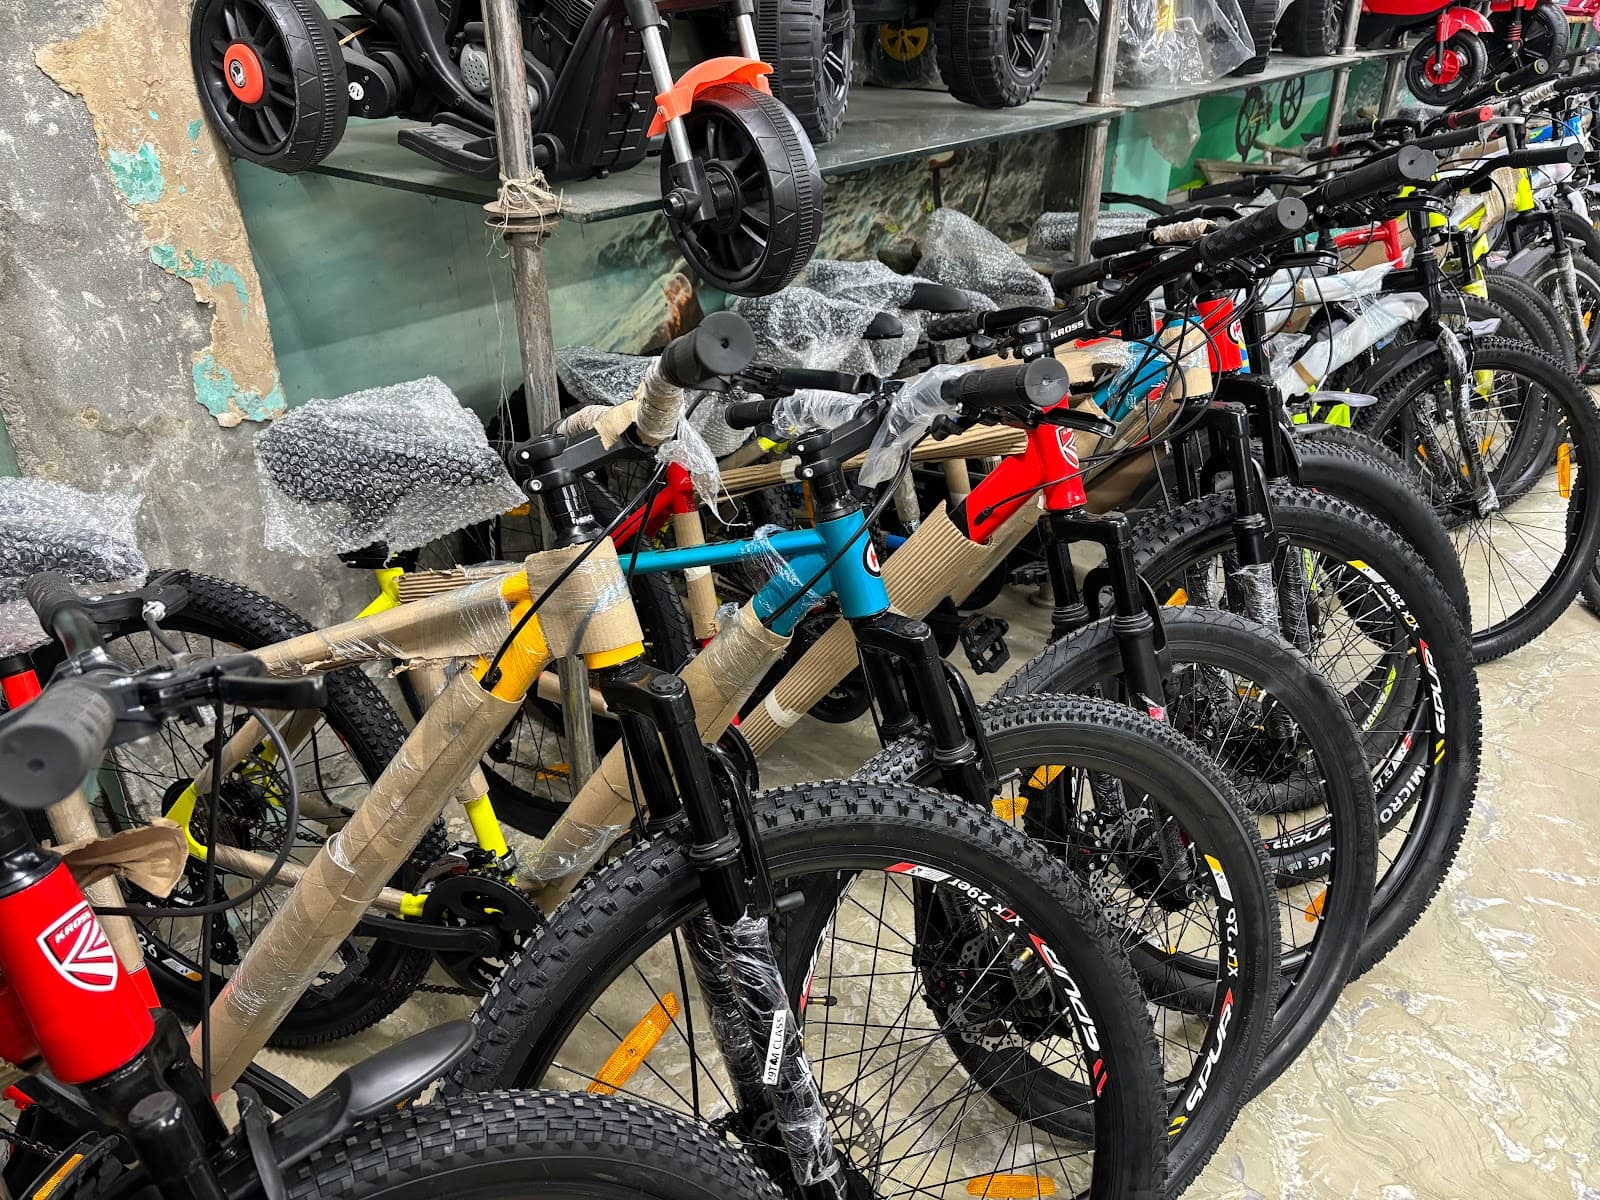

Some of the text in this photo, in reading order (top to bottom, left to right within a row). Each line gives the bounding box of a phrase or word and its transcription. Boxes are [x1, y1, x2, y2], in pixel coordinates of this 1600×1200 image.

[1050, 320, 1084, 340] KROSS
[1380, 584, 1406, 609] 29er
[1425, 647, 1446, 735] SPUR
[1380, 765, 1426, 823] MICRO
[947, 878, 992, 905] 29er
[54, 910, 92, 944] KROSS
[1041, 943, 1100, 1052] SPUR
[1185, 1003, 1232, 1111] SPUR
[1225, 907, 1239, 942] 26
[773, 1016, 784, 1050] CLASS
